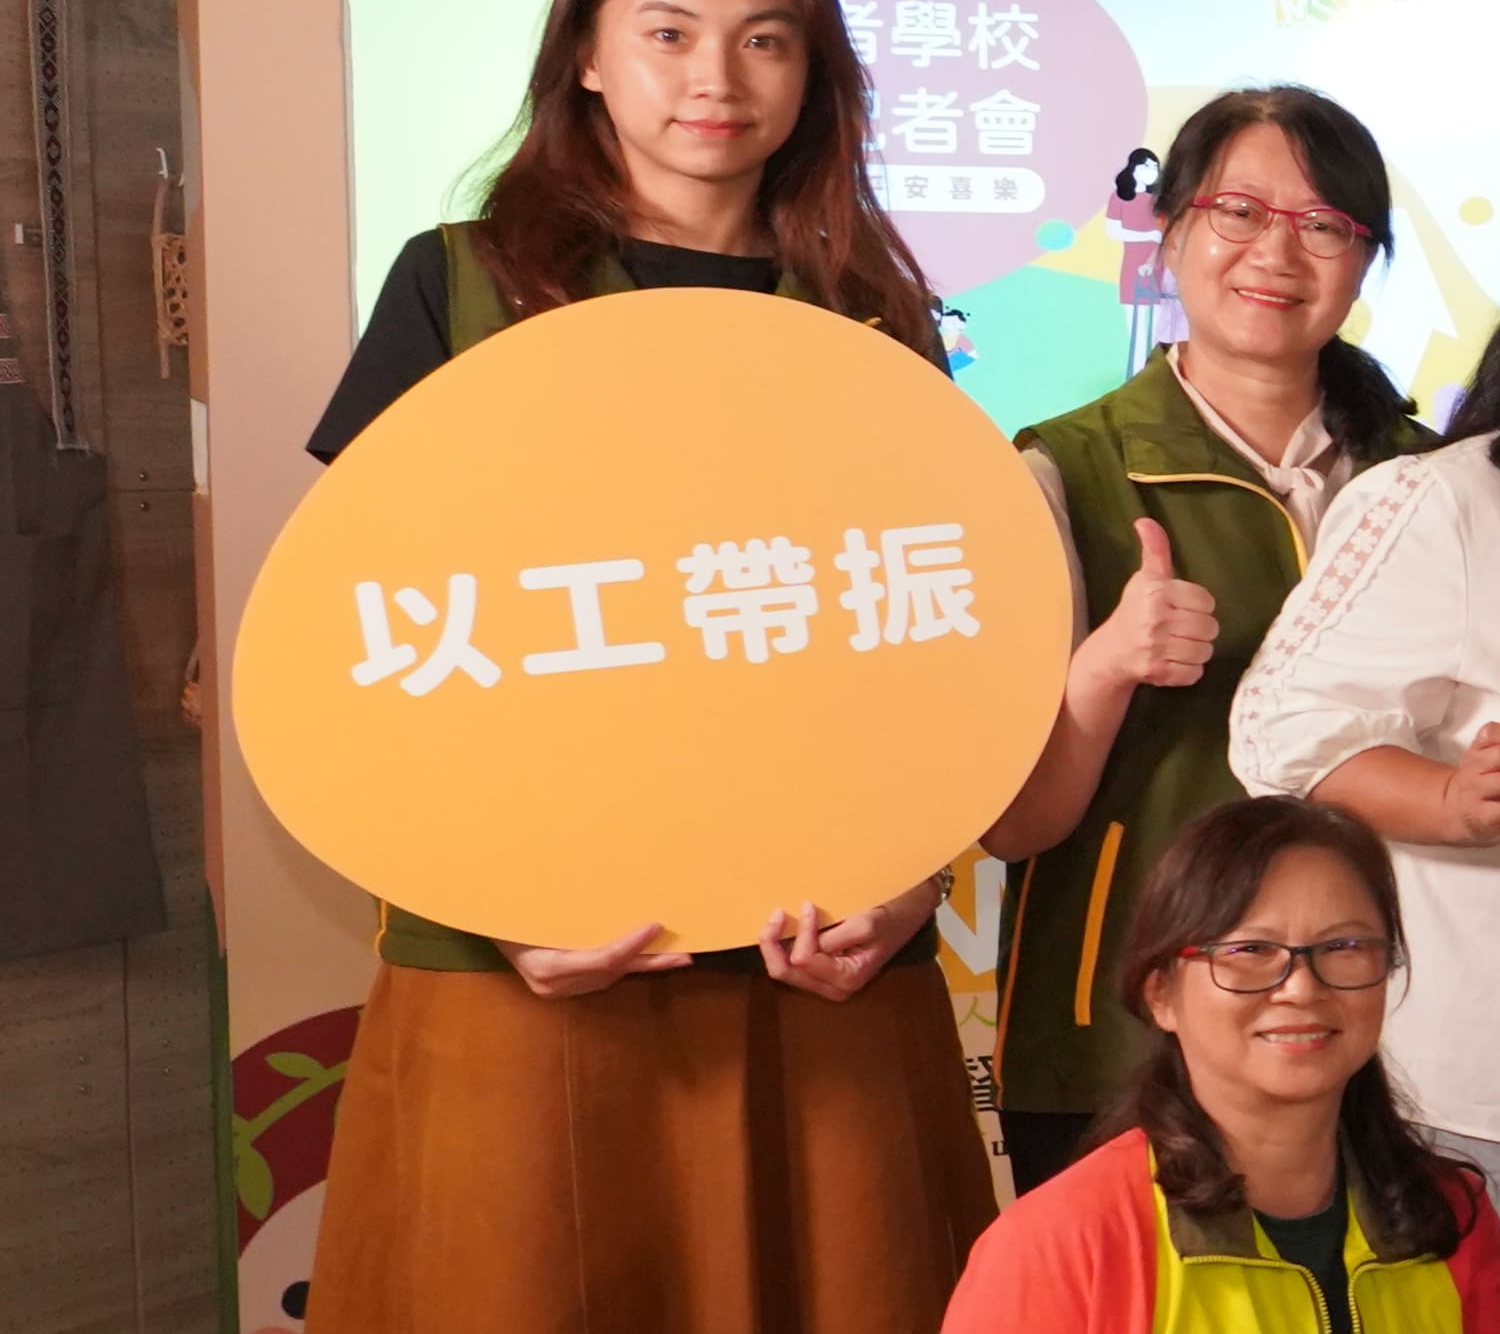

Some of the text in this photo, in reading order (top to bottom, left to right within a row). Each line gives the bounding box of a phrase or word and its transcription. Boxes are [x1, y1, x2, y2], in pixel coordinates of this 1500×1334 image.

[862, 87, 1041, 155] 者會
[351, 522, 981, 697] 以工帶振
